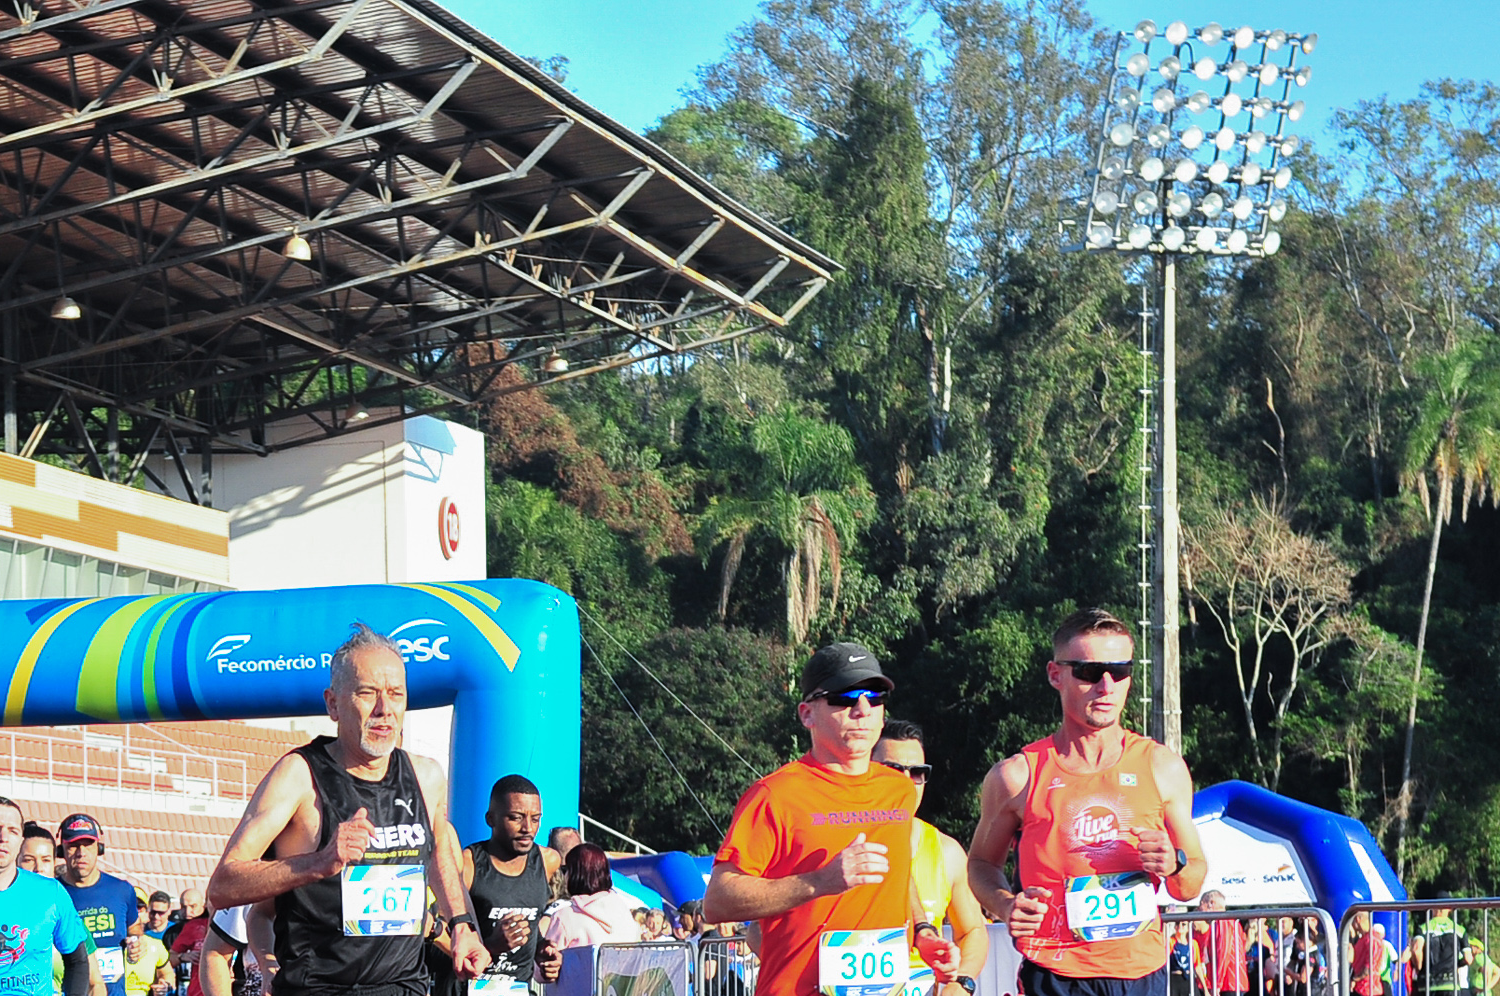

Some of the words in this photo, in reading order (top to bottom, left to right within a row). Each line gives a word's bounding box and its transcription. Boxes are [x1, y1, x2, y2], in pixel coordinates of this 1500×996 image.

[399, 635, 450, 663] esc
[217, 655, 317, 673] Fecomércio
[321, 653, 332, 668] R
[827, 809, 905, 825] RUNNING
[1073, 810, 1115, 842] Live
[1095, 829, 1118, 843] run
[363, 887, 413, 914] 267
[1084, 890, 1137, 922] 291
[841, 951, 894, 980] 306
[0, 973, 40, 990] FITNESS
